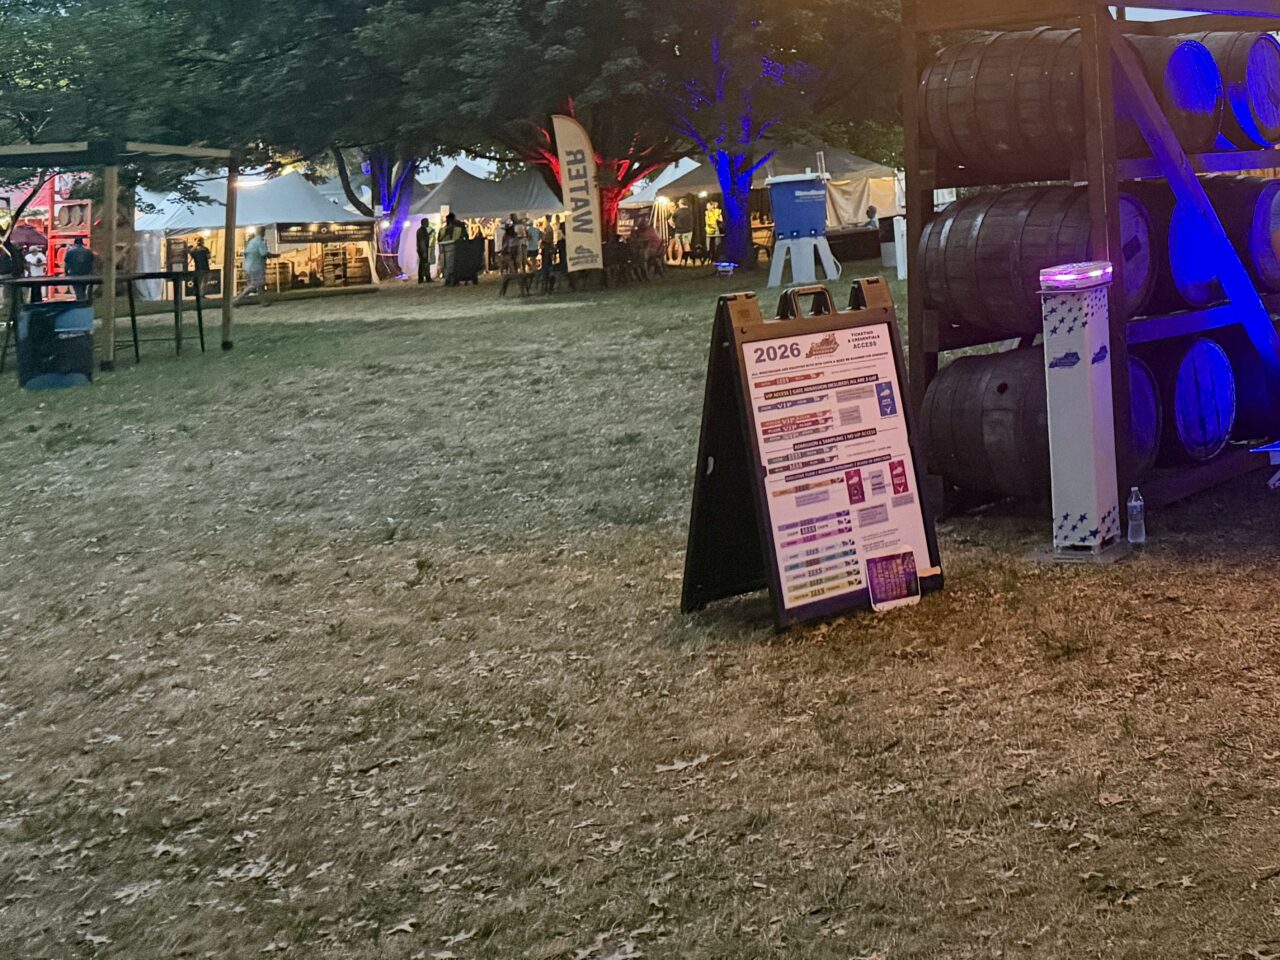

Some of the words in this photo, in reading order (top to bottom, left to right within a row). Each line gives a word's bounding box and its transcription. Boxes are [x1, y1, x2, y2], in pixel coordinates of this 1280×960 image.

[853, 340, 877, 349] ACCESS
[753, 342, 801, 364] 2026
[777, 401, 792, 409] VIP
